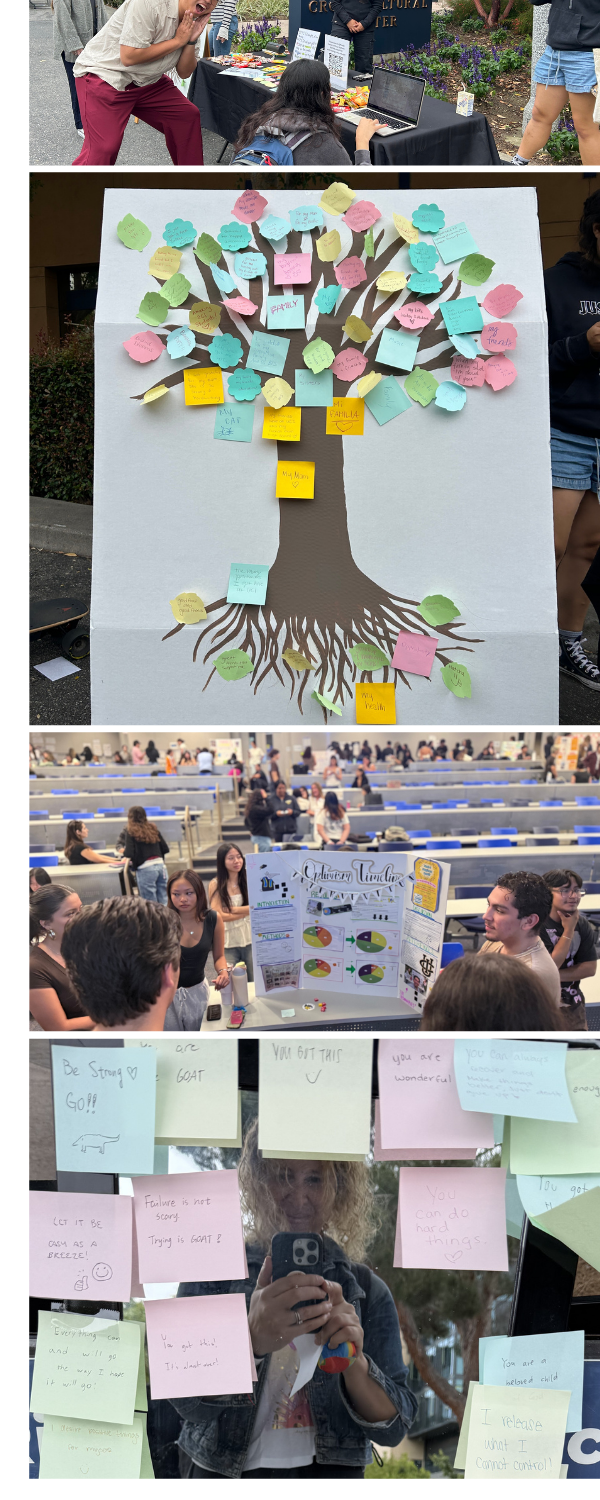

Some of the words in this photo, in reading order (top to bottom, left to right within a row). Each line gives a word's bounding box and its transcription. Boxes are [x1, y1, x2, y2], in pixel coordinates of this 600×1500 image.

[308, 0, 336, 13] CRO
[375, 15, 397, 28] TER
[176, 1041, 200, 1054] are
[319, 1048, 343, 1063] THIS
[392, 1054, 412, 1066] you
[420, 1053, 441, 1062] are
[62, 1059, 80, 1077] Be
[89, 1060, 124, 1089] Strong
[176, 1067, 206, 1084] GOAT
[394, 1073, 452, 1084] wonderful
[144, 1194, 176, 1208] Failure
[182, 1197, 189, 1206] is
[193, 1193, 211, 1206] not
[426, 1184, 456, 1204] You
[415, 1209, 441, 1220] can
[448, 1207, 469, 1220] do
[416, 1220, 449, 1233] hard
[73, 1240, 84, 1248] AS
[90, 1240, 98, 1248] A
[148, 1234, 172, 1248] Trying
[177, 1235, 184, 1243] is
[54, 1326, 98, 1342] Everything
[181, 1341, 193, 1352] got
[49, 1347, 68, 1355] and
[108, 1353, 117, 1361] go
[501, 1357, 516, 1369] You
[522, 1359, 535, 1367] are
[57, 1364, 69, 1372] the
[76, 1368, 92, 1376] way
[98, 1367, 104, 1376] I
[46, 1378, 55, 1386] it
[62, 1379, 77, 1388] will
[505, 1377, 534, 1386] beloved
[540, 1371, 558, 1383] child
[480, 1408, 491, 1426] I
[501, 1414, 543, 1432] release
[484, 1437, 509, 1451] what
[518, 1439, 528, 1453] I
[513, 1457, 553, 1472] control!
